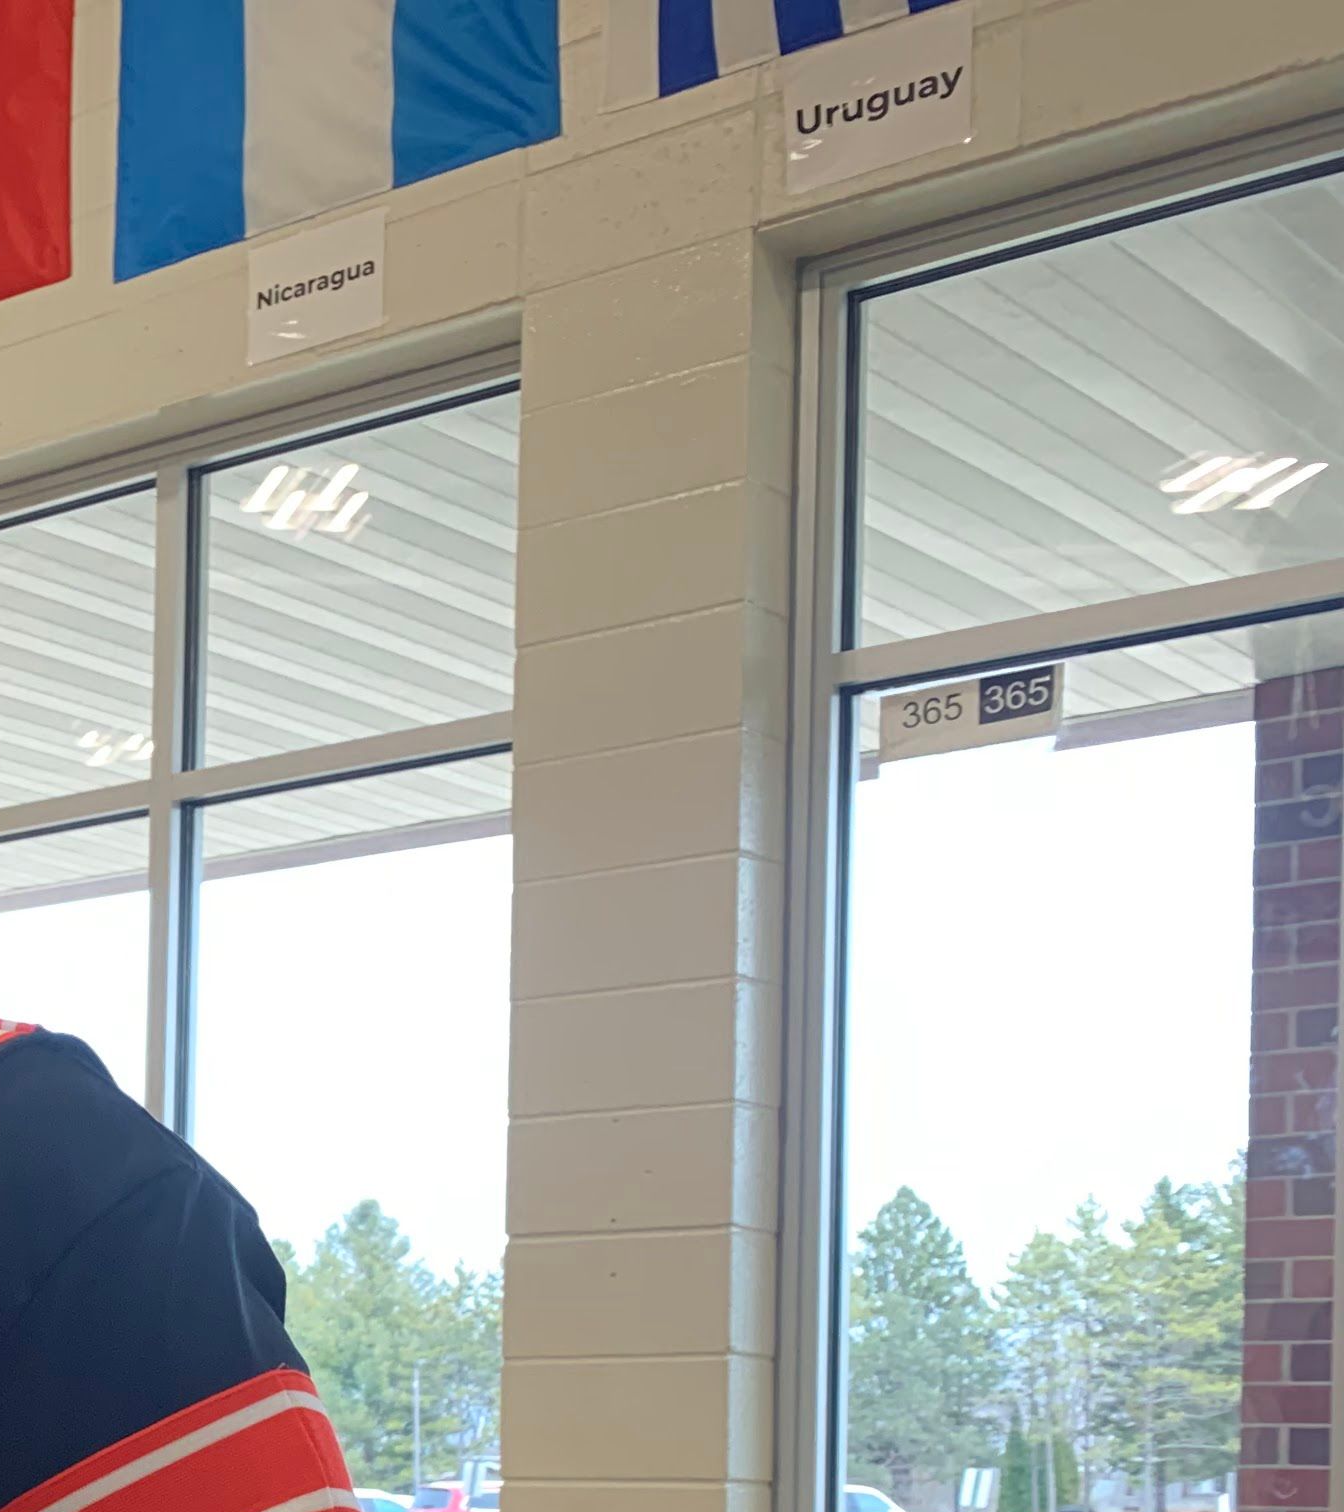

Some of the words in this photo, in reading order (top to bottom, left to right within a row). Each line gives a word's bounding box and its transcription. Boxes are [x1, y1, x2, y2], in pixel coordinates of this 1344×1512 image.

[796, 66, 964, 135] Uruguay
[256, 260, 376, 310] Nicaragua
[902, 692, 963, 729] 365
[984, 674, 1052, 715] 365
